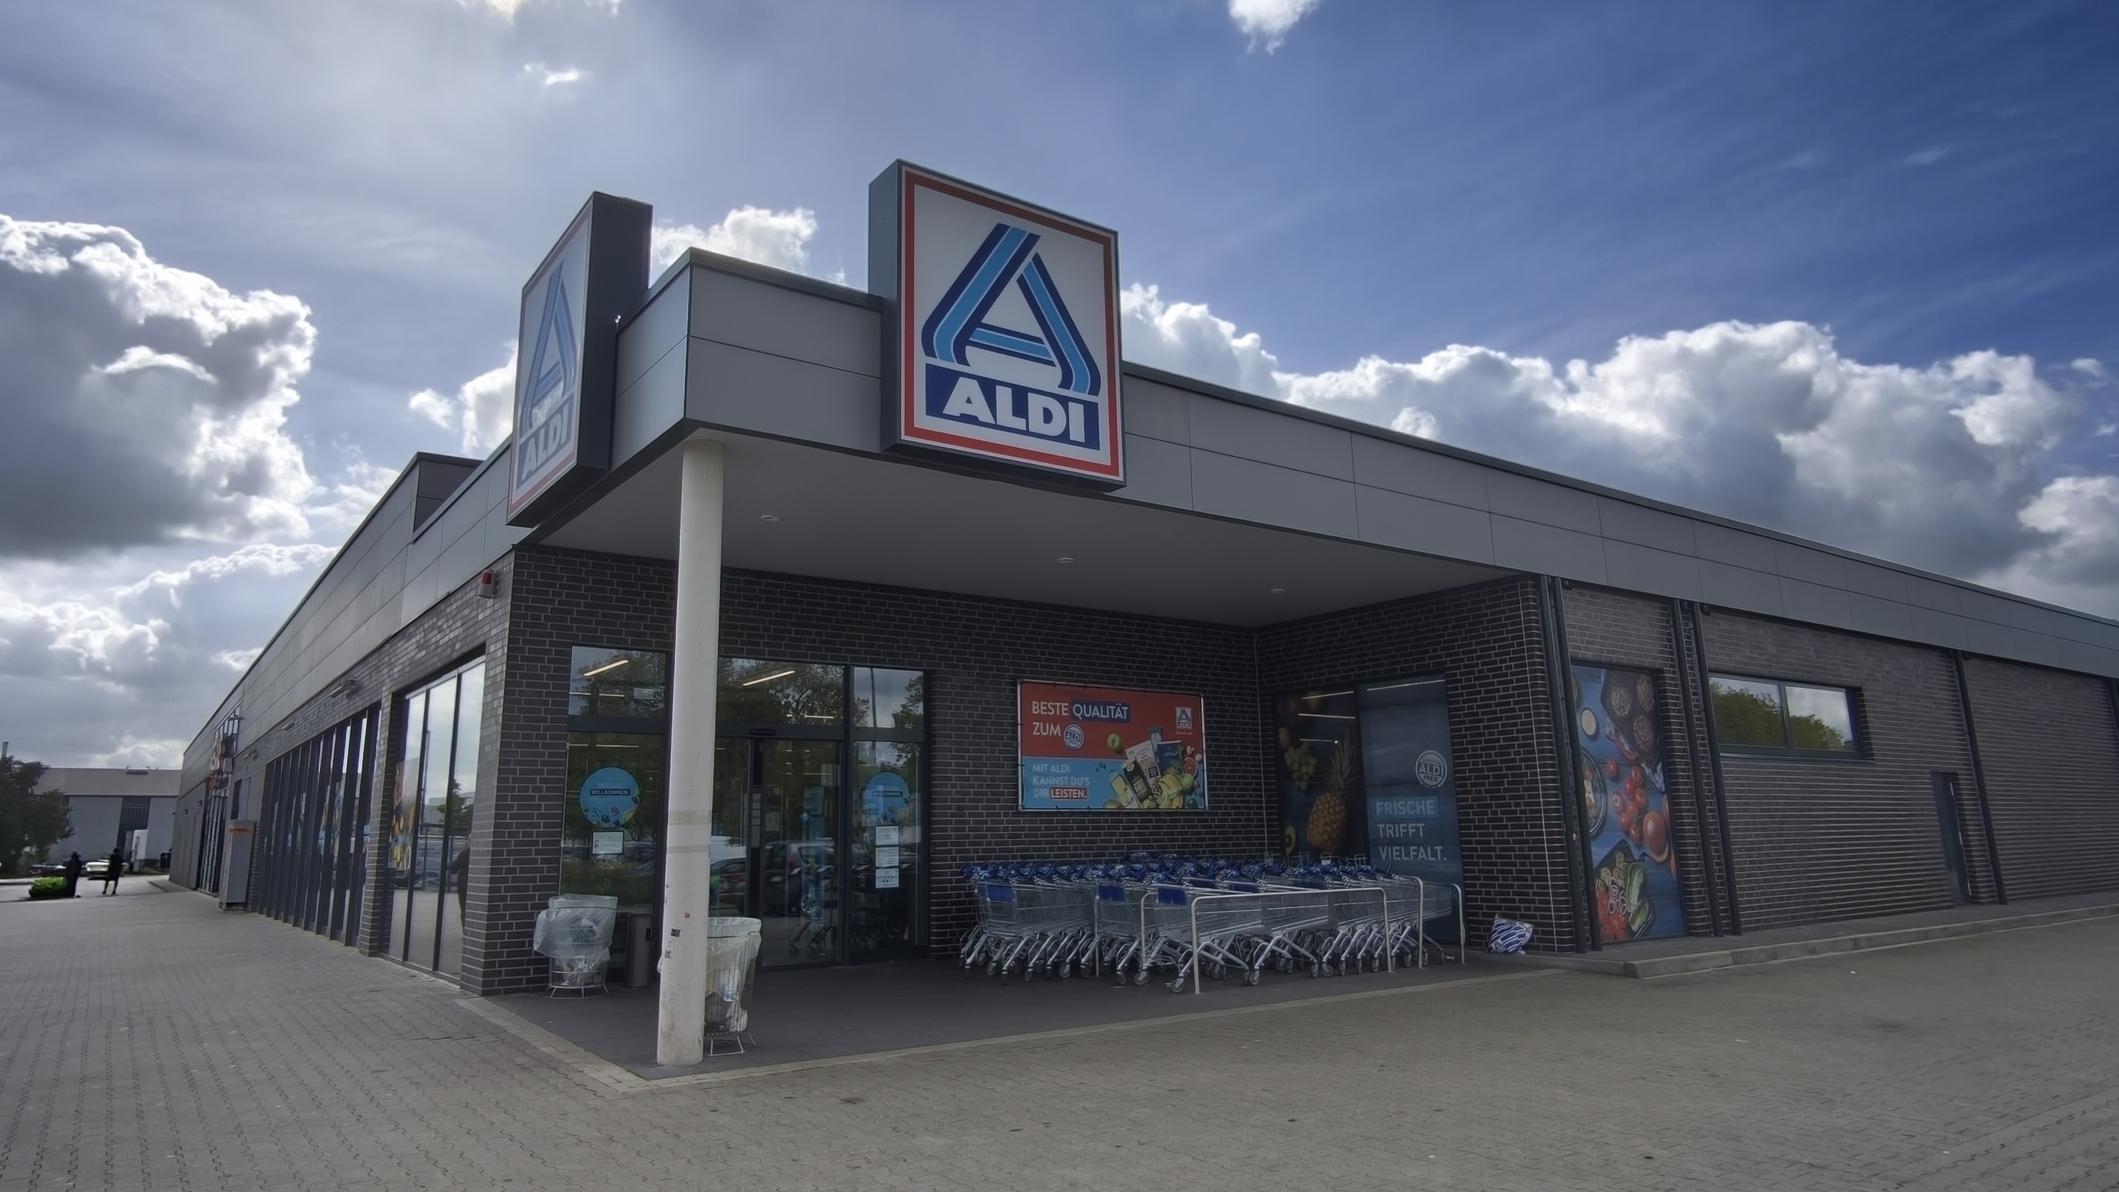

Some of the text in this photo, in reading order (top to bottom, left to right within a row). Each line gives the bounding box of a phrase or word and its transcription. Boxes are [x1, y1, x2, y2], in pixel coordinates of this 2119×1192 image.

[942, 376, 1085, 443] ALDI
[521, 401, 569, 480] ALDI
[1032, 701, 1129, 720] BESTE QUALITÄT
[1032, 722, 1062, 736] ZUM
[1032, 764, 1071, 773] MIT ALDI
[1418, 763, 1444, 776] ALDI
[1032, 776, 1091, 786] KANNST DU'S
[1051, 789, 1087, 798] LEISTEN.
[1375, 800, 1436, 816] FRISCHE
[1376, 823, 1425, 838] TRIFFT
[1379, 846, 1447, 861] VIELFALT.
